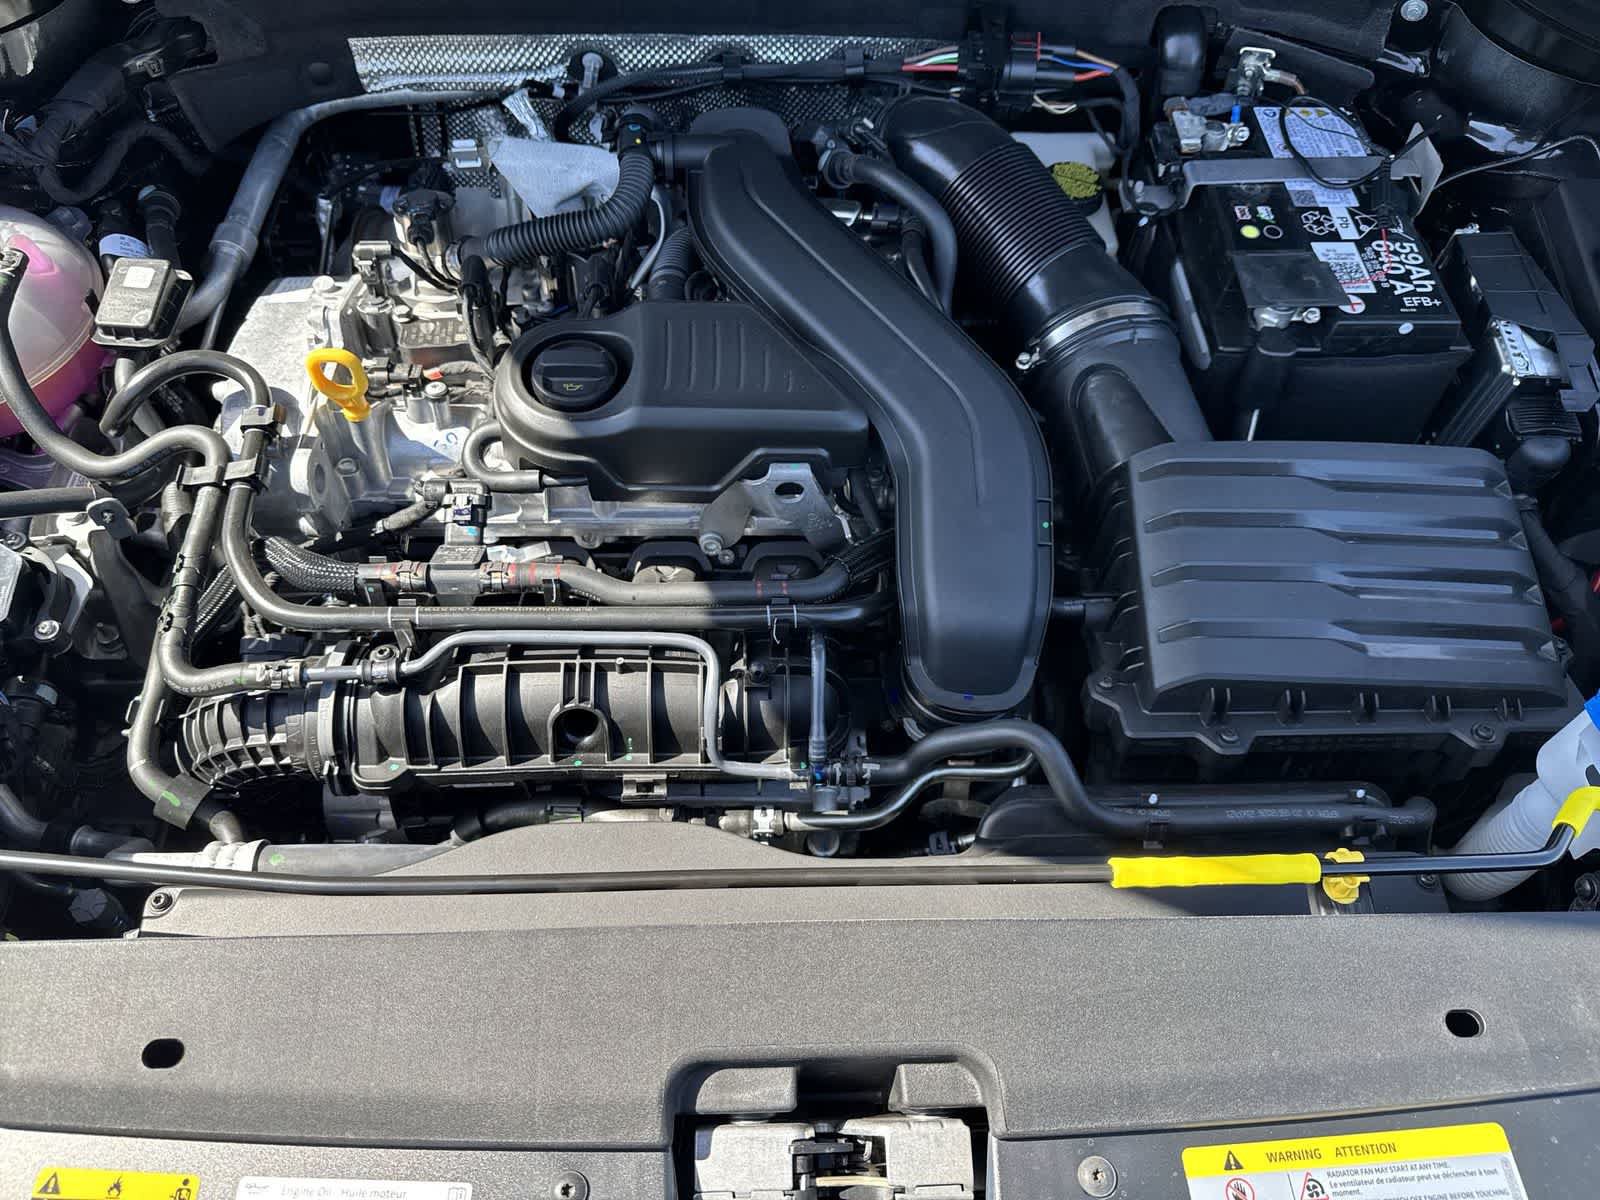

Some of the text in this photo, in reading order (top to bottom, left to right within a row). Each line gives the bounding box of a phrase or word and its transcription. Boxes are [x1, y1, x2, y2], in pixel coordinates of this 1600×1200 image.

[1335, 216, 1350, 230] Pb
[1371, 240, 1407, 275] 640
[1395, 240, 1436, 293] 59Ah
[1388, 279, 1415, 296] A
[1402, 295, 1442, 308] EFB+
[1265, 1142, 1397, 1163] WARNING ATTENTION
[1326, 1168, 1360, 1178] RADIATOR
[1360, 1167, 1374, 1175] FAN
[1374, 1166, 1388, 1174] MAY
[1388, 1163, 1409, 1173] START
[1418, 1162, 1432, 1170] ANY
[1328, 1180, 1338, 1189] Le
[1338, 1177, 1375, 1188] ventilateur
[1375, 1176, 1385, 1185] de
